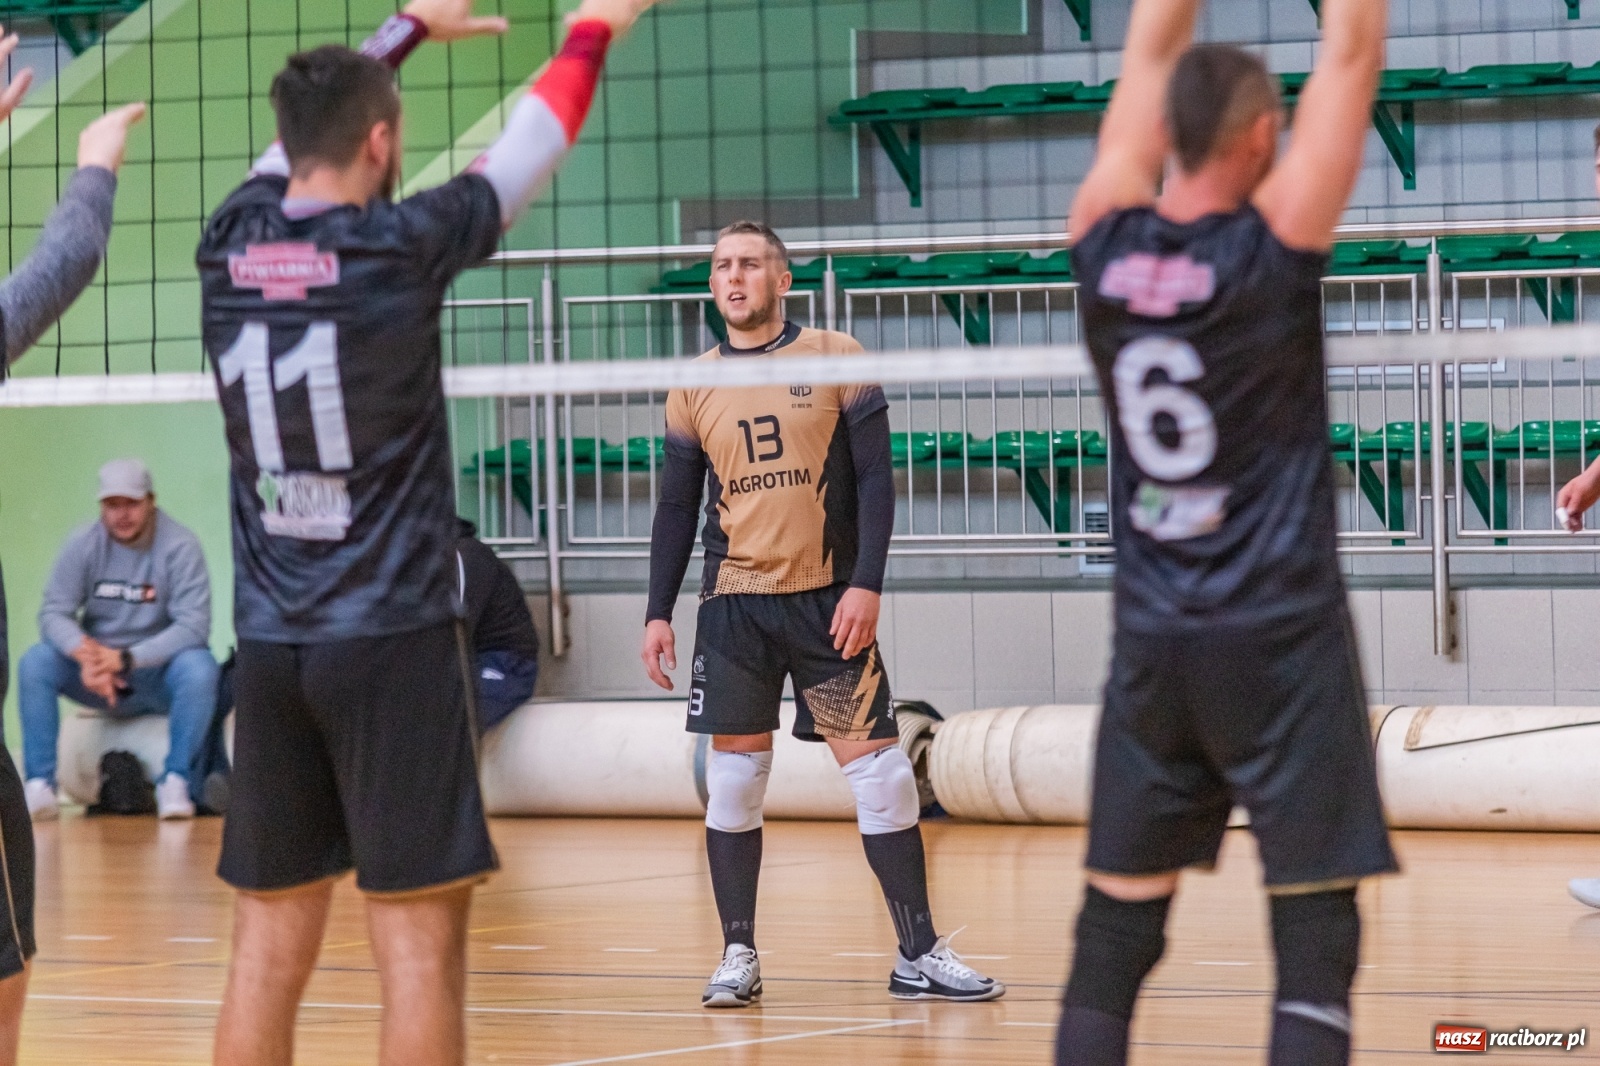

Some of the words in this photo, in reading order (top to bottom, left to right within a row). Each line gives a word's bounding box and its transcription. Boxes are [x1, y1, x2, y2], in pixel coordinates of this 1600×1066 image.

[218, 320, 353, 471] 11
[737, 414, 784, 464] 13
[1112, 335, 1218, 481] 6
[729, 468, 812, 496] AGROTIM
